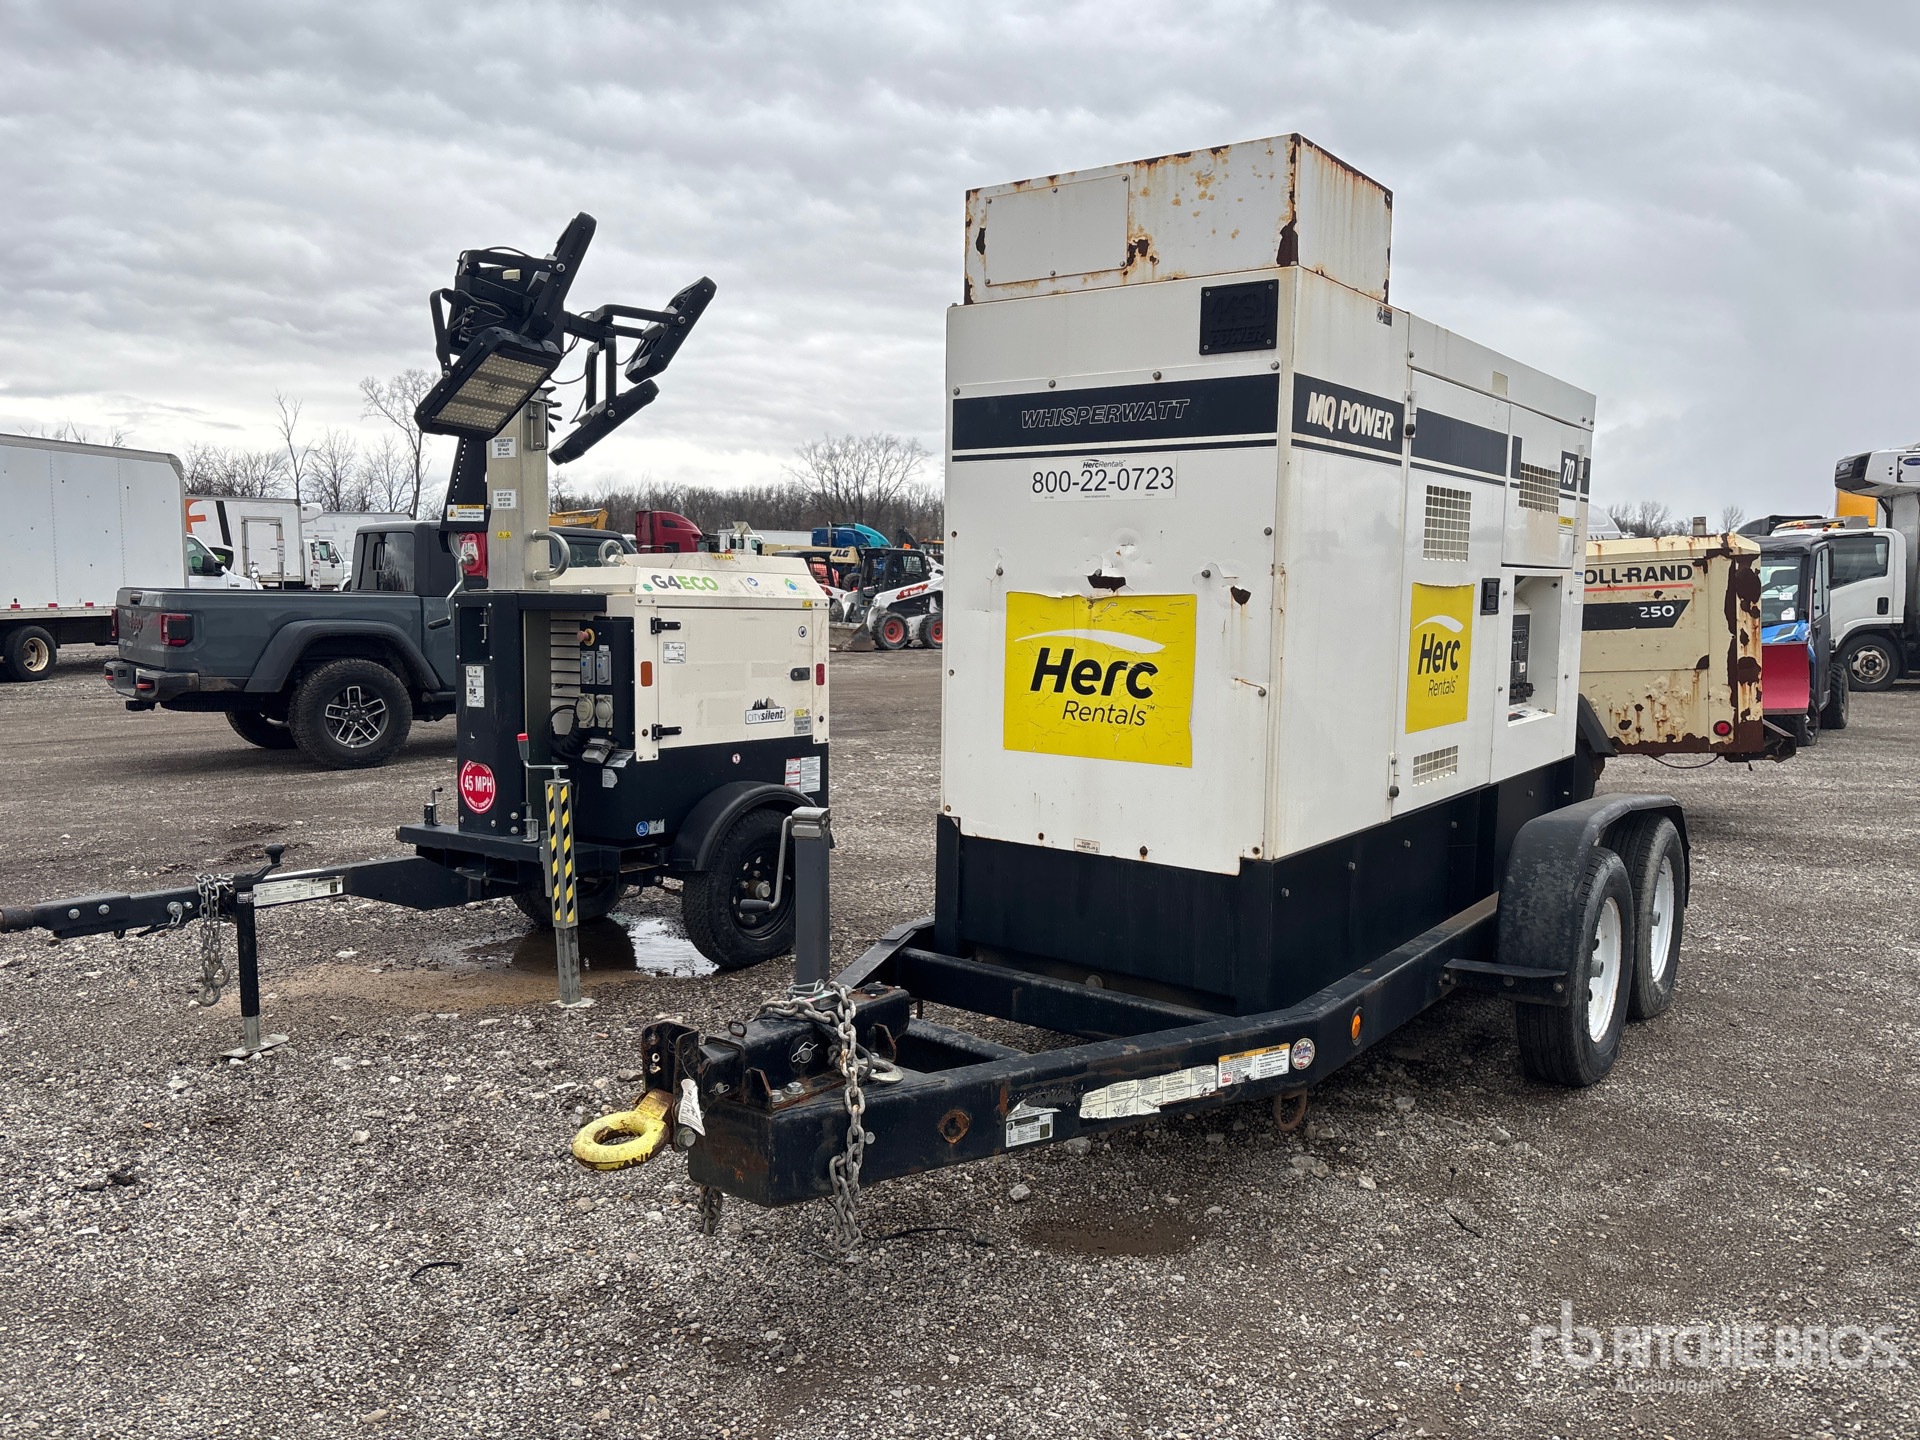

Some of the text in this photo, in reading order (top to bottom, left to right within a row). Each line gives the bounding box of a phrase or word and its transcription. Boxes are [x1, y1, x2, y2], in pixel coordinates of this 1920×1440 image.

[1021, 399, 1190, 428] WHISPERWATT
[1306, 391, 1395, 441] MQ POWER
[1032, 466, 1174, 494] 800-22-0723
[1563, 458, 1575, 485] 70
[832, 549, 850, 558] JLG
[651, 575, 719, 591] G4ECO
[1639, 605, 1675, 618] 250
[1417, 633, 1461, 675] Herc
[1030, 647, 1159, 700] Herc
[465, 776, 492, 793] 45 MPH
